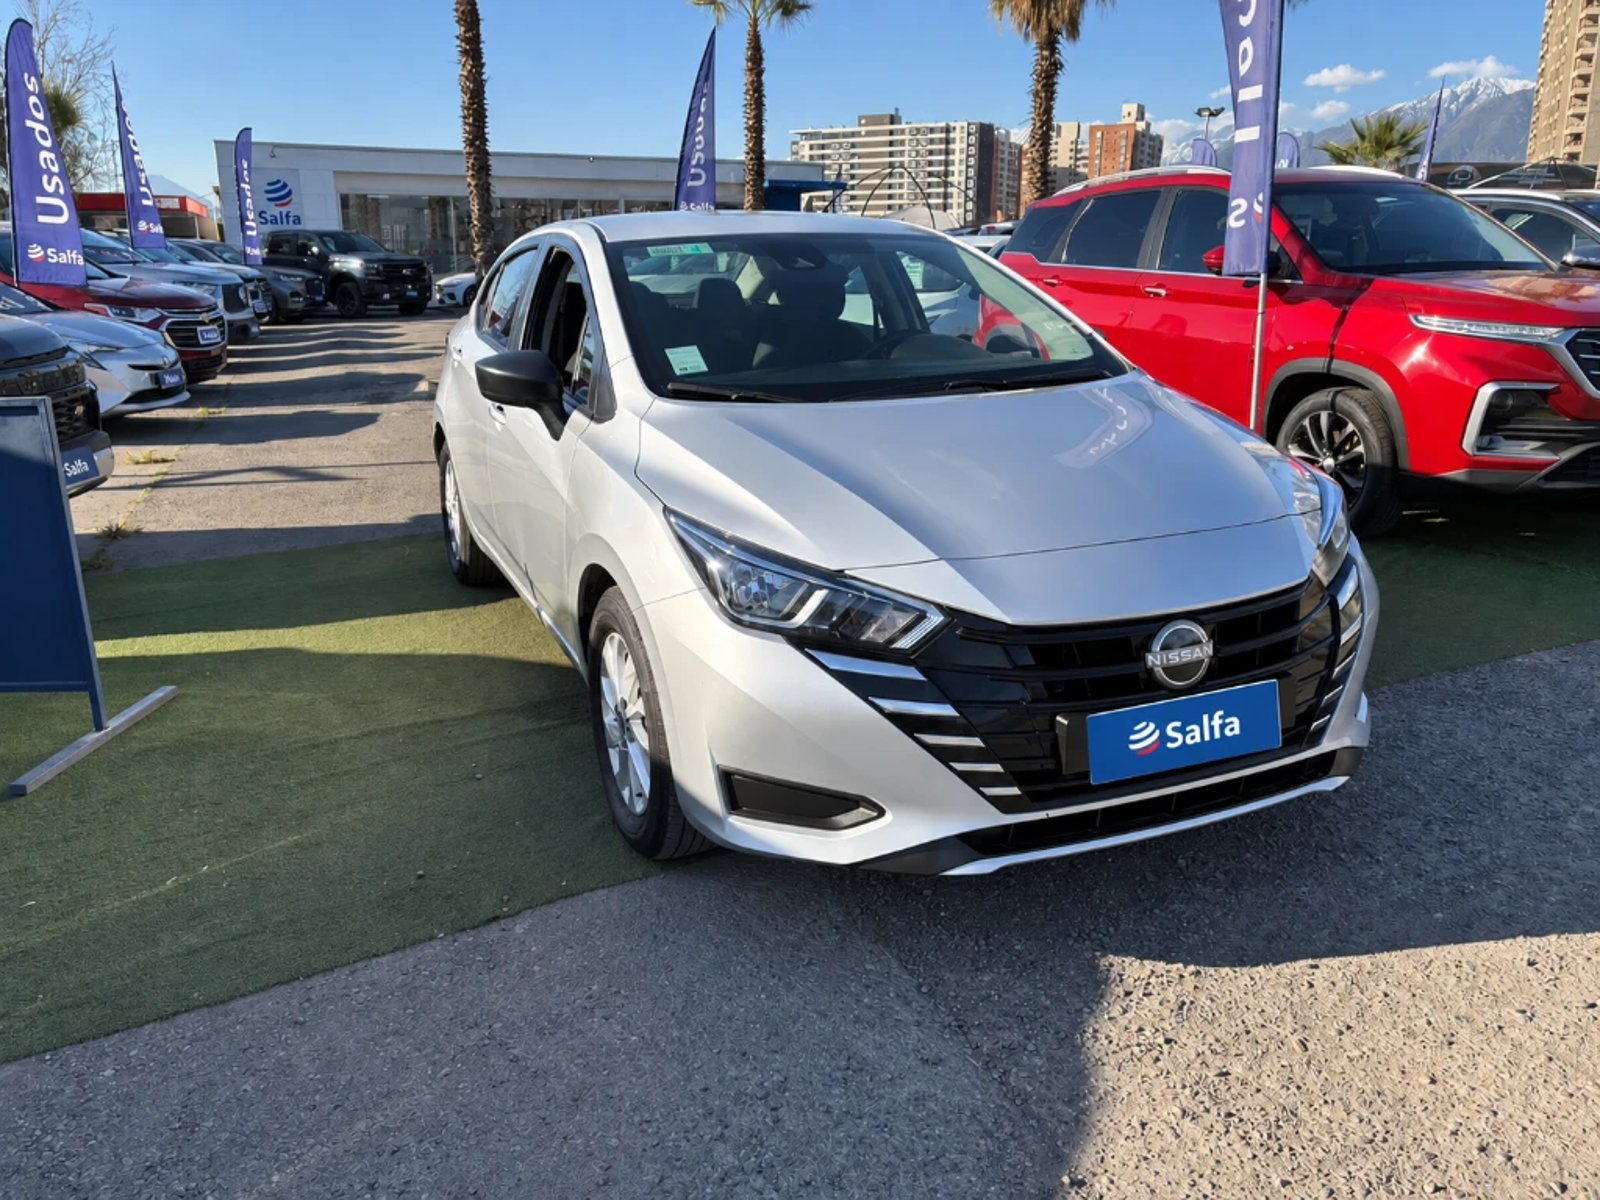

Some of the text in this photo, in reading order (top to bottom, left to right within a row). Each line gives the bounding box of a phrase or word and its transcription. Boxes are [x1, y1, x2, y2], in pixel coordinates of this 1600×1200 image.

[24, 72, 69, 225] Usados
[259, 210, 302, 226] Salfa
[47, 248, 84, 266] Salfa
[1147, 641, 1213, 667] NISSAN
[1165, 710, 1241, 749] Salfa
